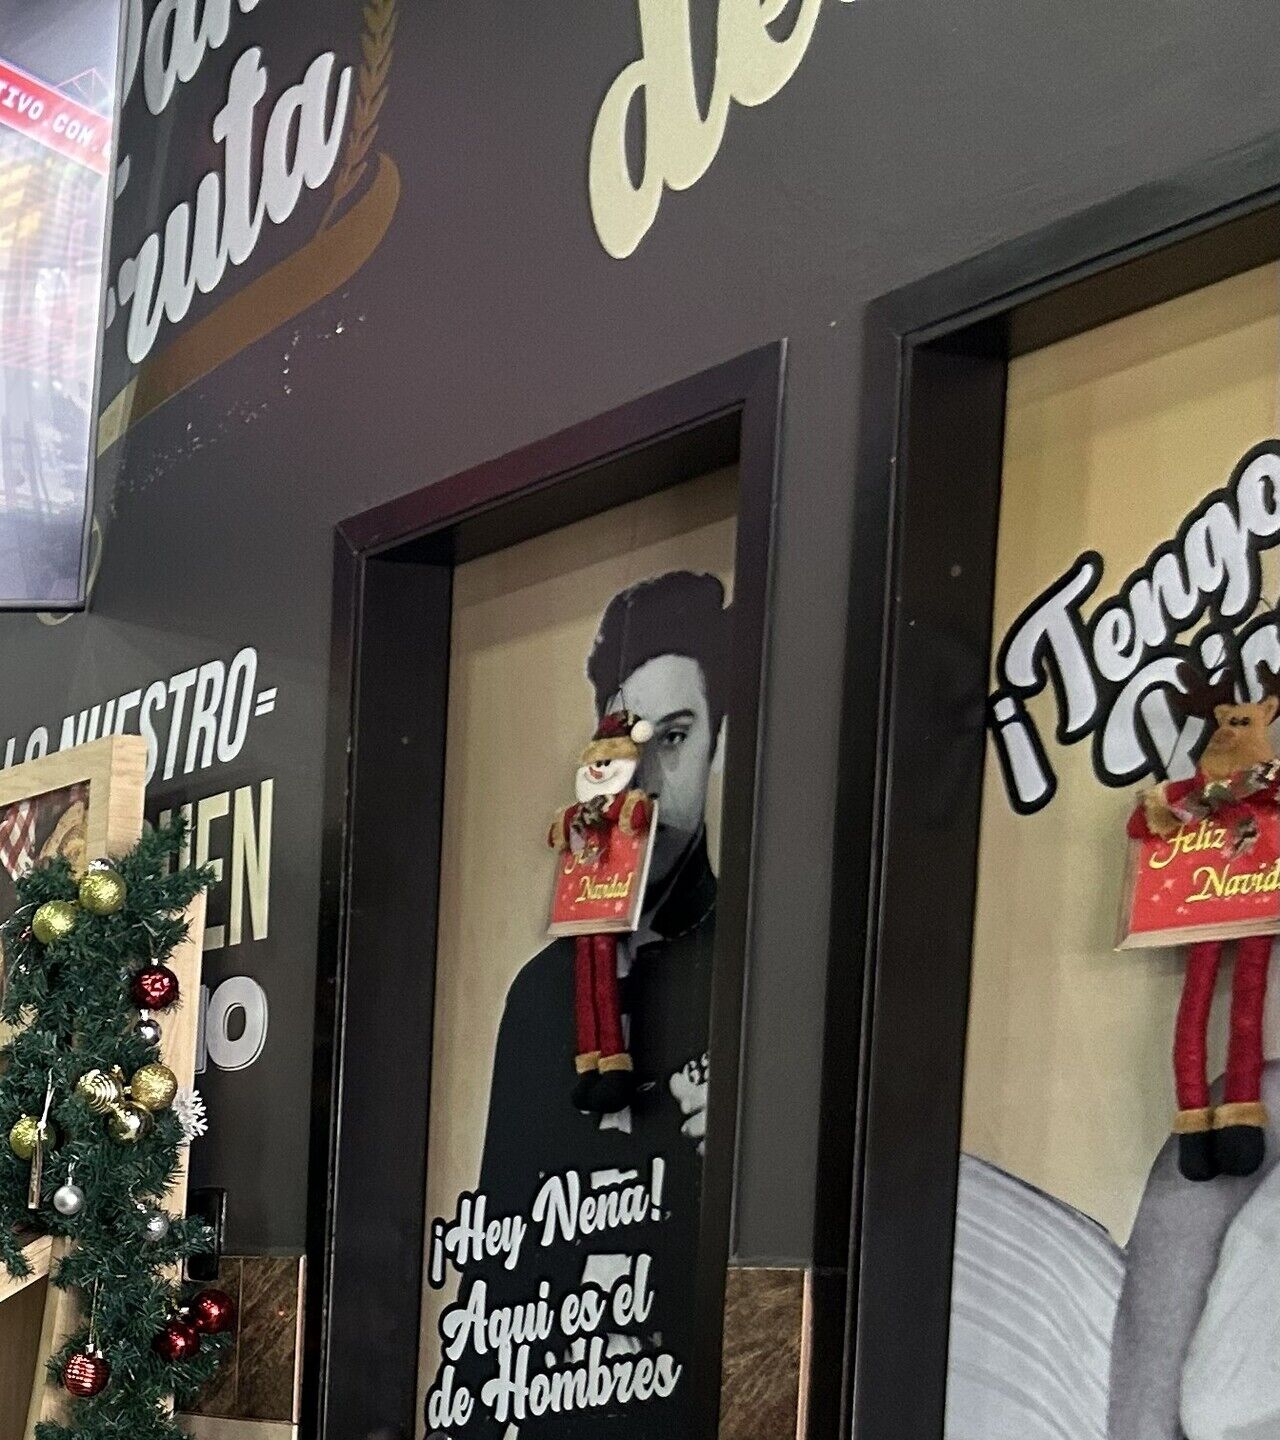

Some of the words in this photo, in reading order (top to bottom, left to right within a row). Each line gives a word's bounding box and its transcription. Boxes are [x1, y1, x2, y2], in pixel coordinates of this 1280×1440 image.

[105, 46, 352, 364] ruta
[990, 450, 1280, 806] ¡Tengo
[432, 1194, 527, 1282] ¡Hey
[560, 1289, 607, 1336] es
[612, 1253, 655, 1327] el
[428, 1364, 475, 1429] de
[481, 1336, 683, 1423] Hombres
